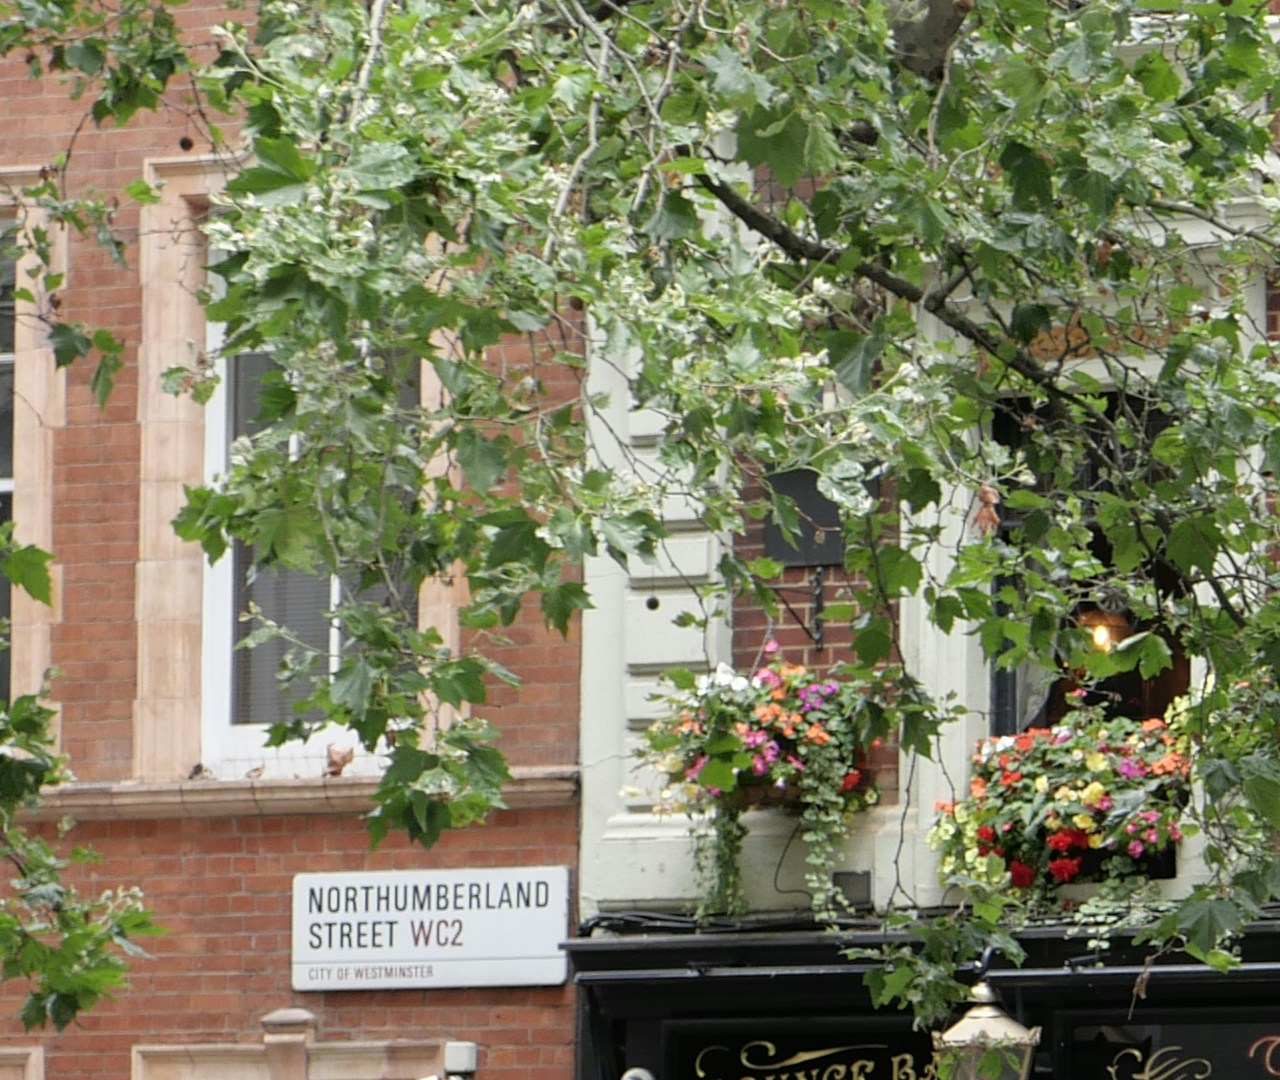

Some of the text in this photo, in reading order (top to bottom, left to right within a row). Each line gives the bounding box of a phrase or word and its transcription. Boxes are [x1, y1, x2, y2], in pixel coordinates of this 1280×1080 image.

[308, 881, 550, 914] NORTHUMBERLAND
[308, 919, 464, 949] STREET WC2
[308, 965, 434, 981] CITY OF WESTMINSTER
